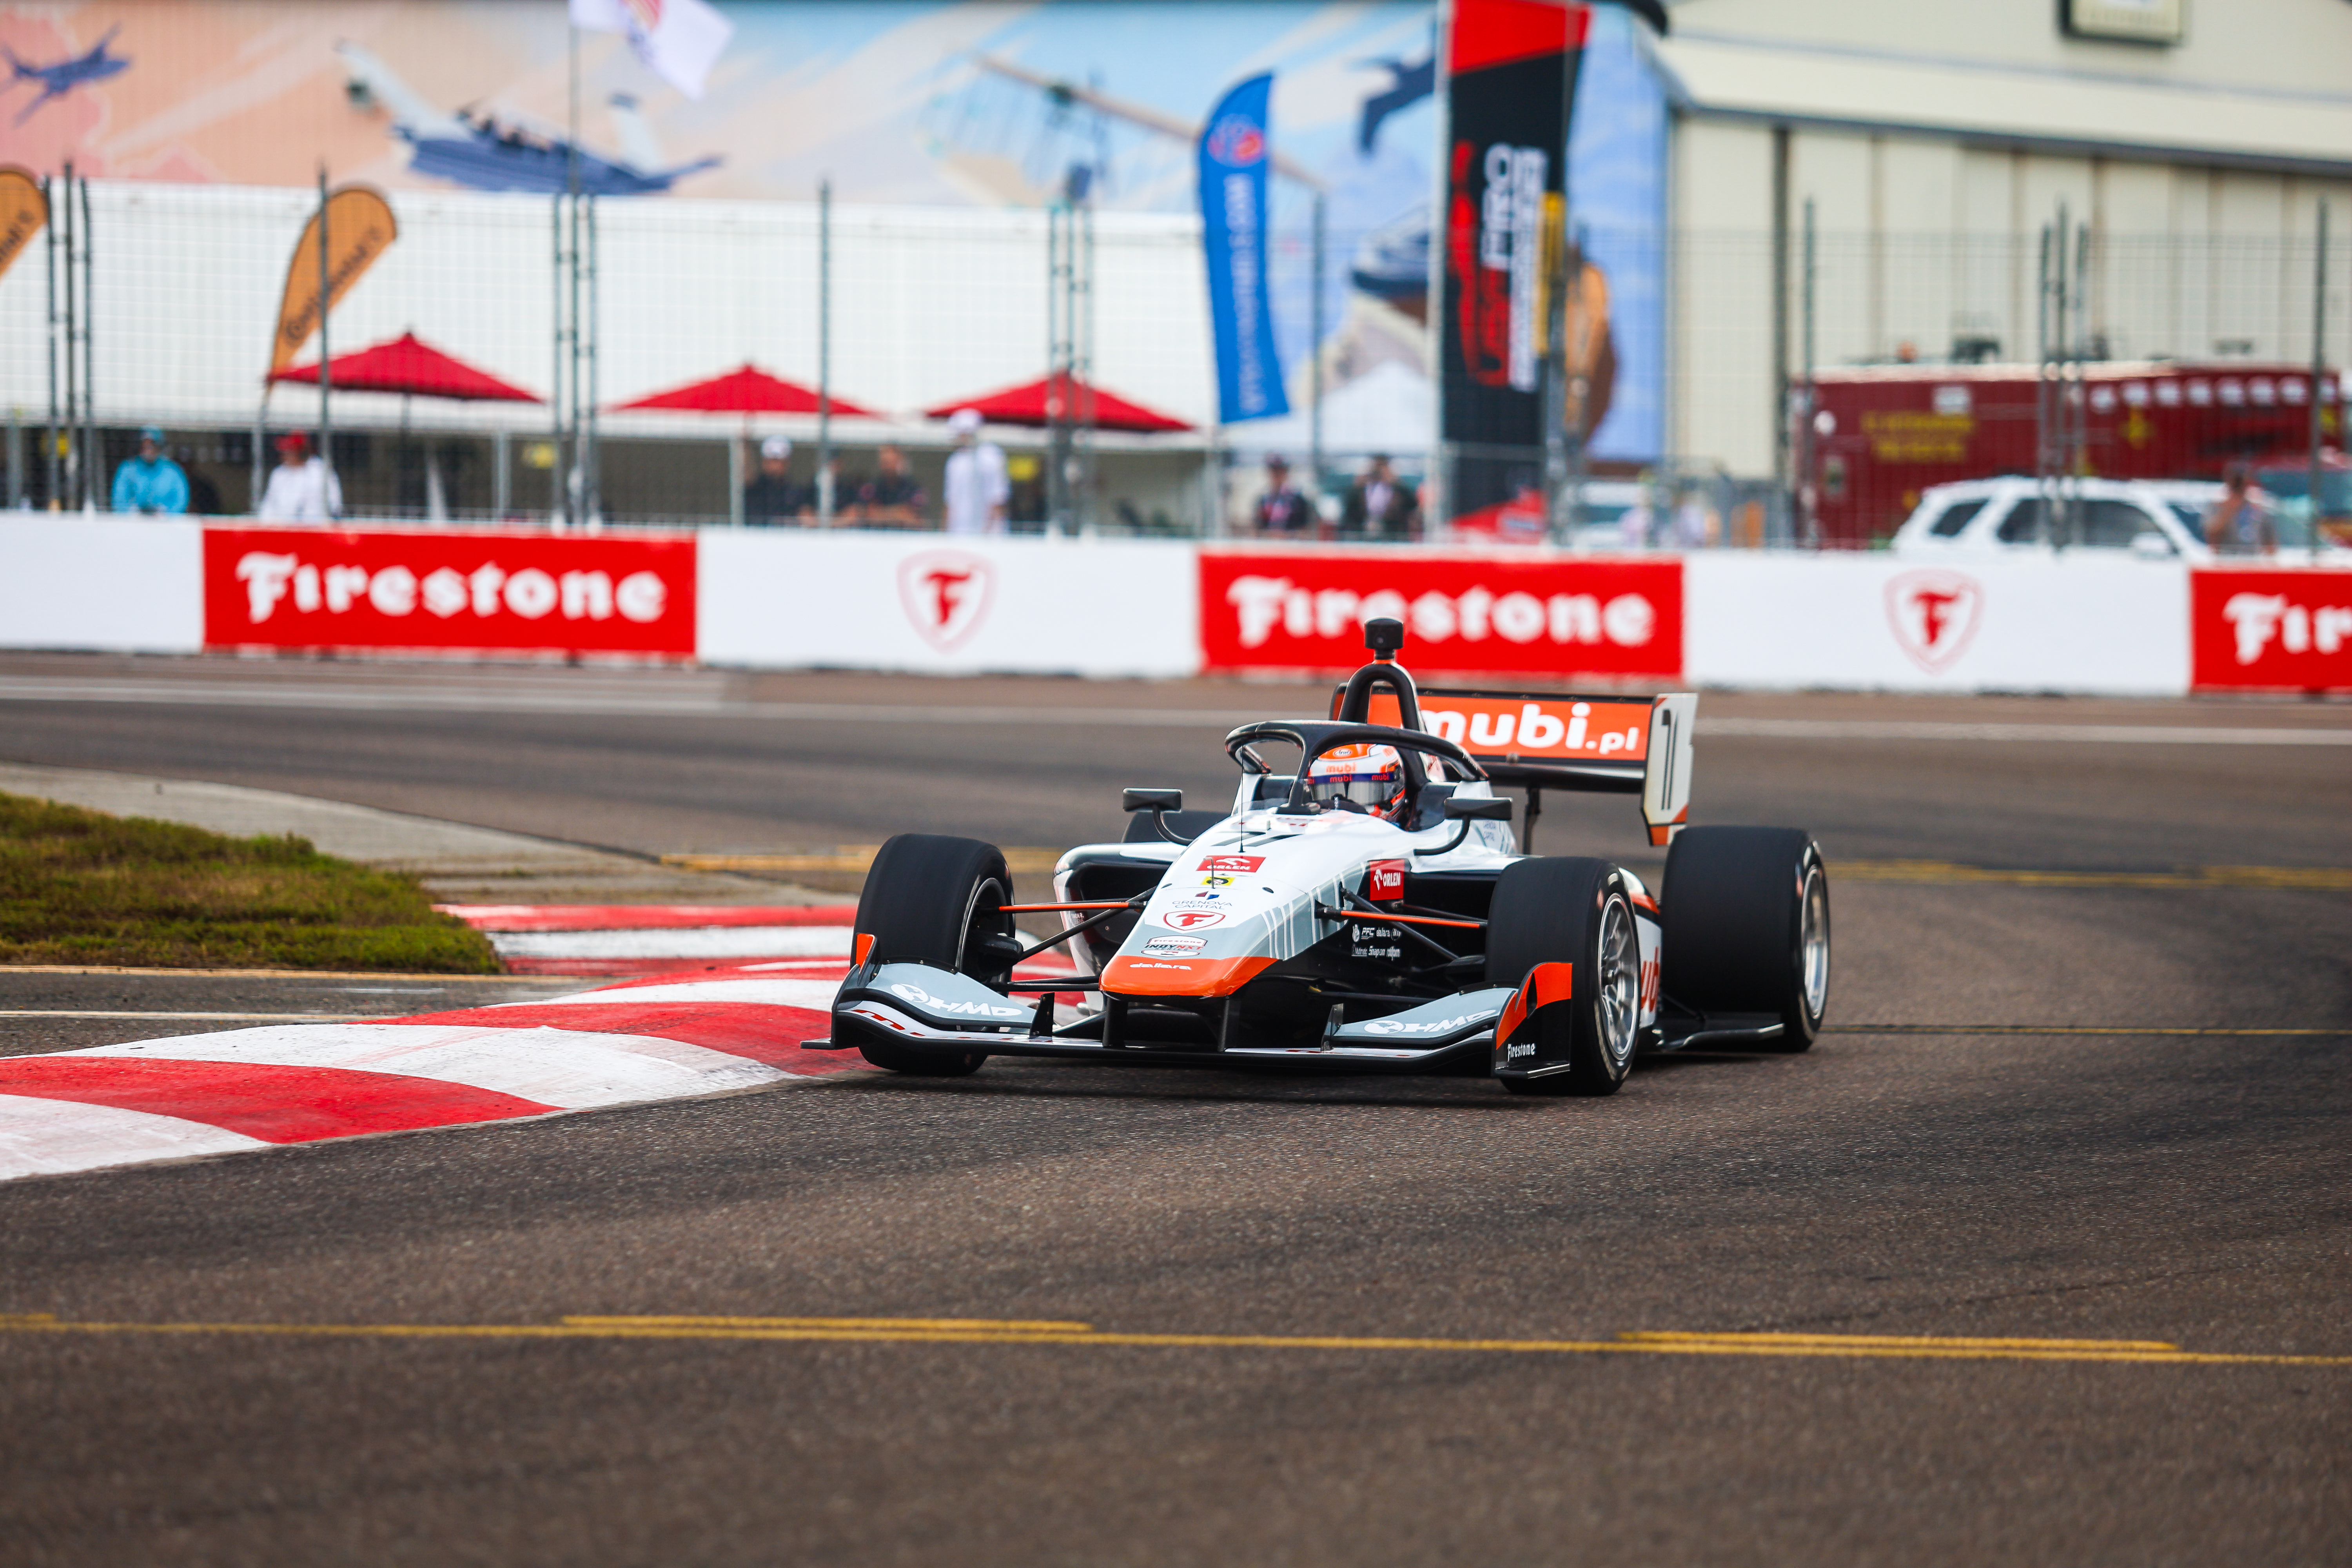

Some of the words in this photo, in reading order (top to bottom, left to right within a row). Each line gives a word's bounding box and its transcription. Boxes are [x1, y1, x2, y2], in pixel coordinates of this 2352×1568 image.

[236, 550, 666, 623] Firestone
[1227, 574, 1655, 648] Firestone
[1421, 702, 1639, 755] mubi.pl
[1326, 761, 1357, 773] mubi
[1330, 775, 1352, 783] mubi
[1383, 872, 1401, 887] ORLEN
[925, 995, 1022, 1016] HMD
[1401, 1009, 1497, 1032] HMD
[1507, 1043, 1535, 1062] Firestone
